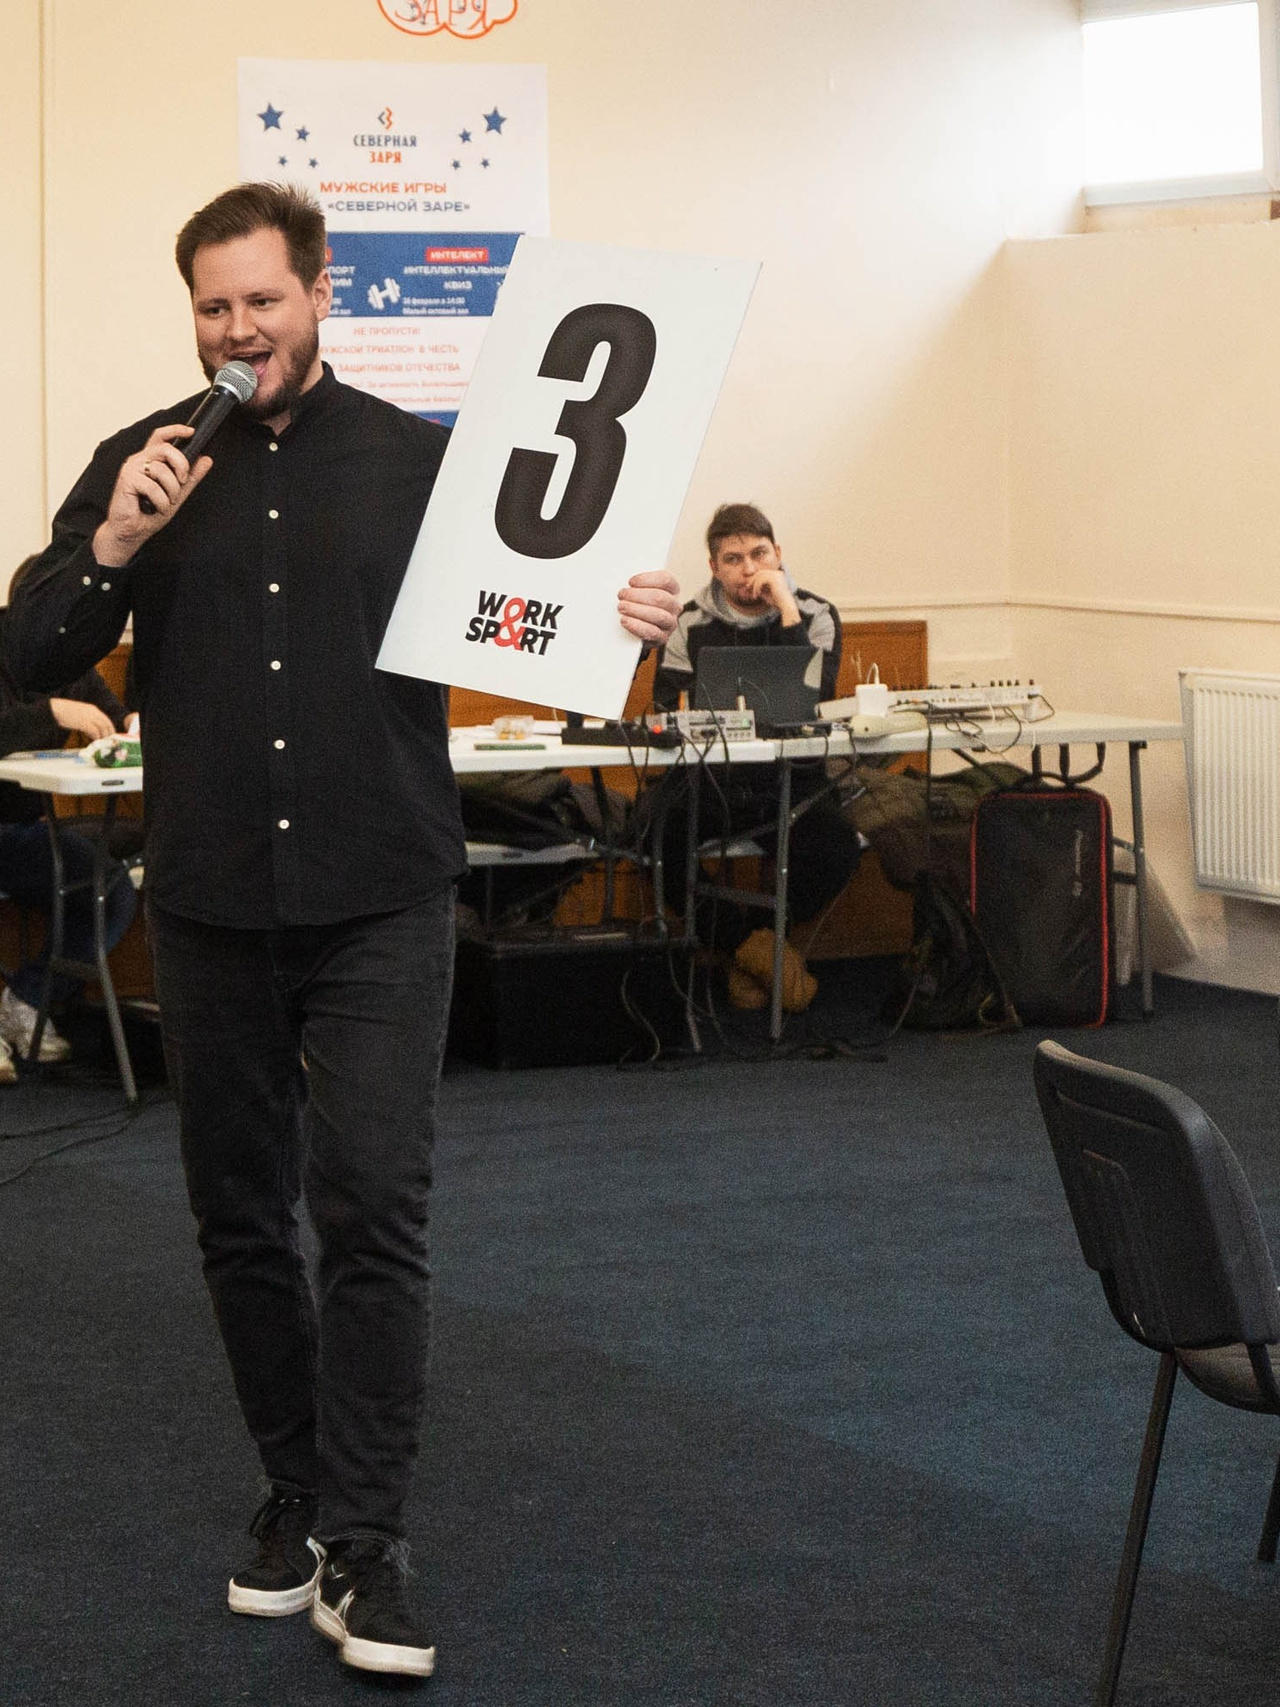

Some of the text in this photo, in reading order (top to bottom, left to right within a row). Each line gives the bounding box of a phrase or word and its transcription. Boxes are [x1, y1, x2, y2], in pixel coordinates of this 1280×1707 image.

[353, 134, 417, 147] СЕВЕРНАЯ
[370, 151, 402, 163] ЗАРЯ
[320, 182, 447, 193] МУЖСКИЕ ИГРЫ
[328, 199, 470, 212] «СЕВЕРНОЙ ЗАРЕ»
[326, 266, 355, 274] ПОРТ
[494, 303, 657, 560] 3
